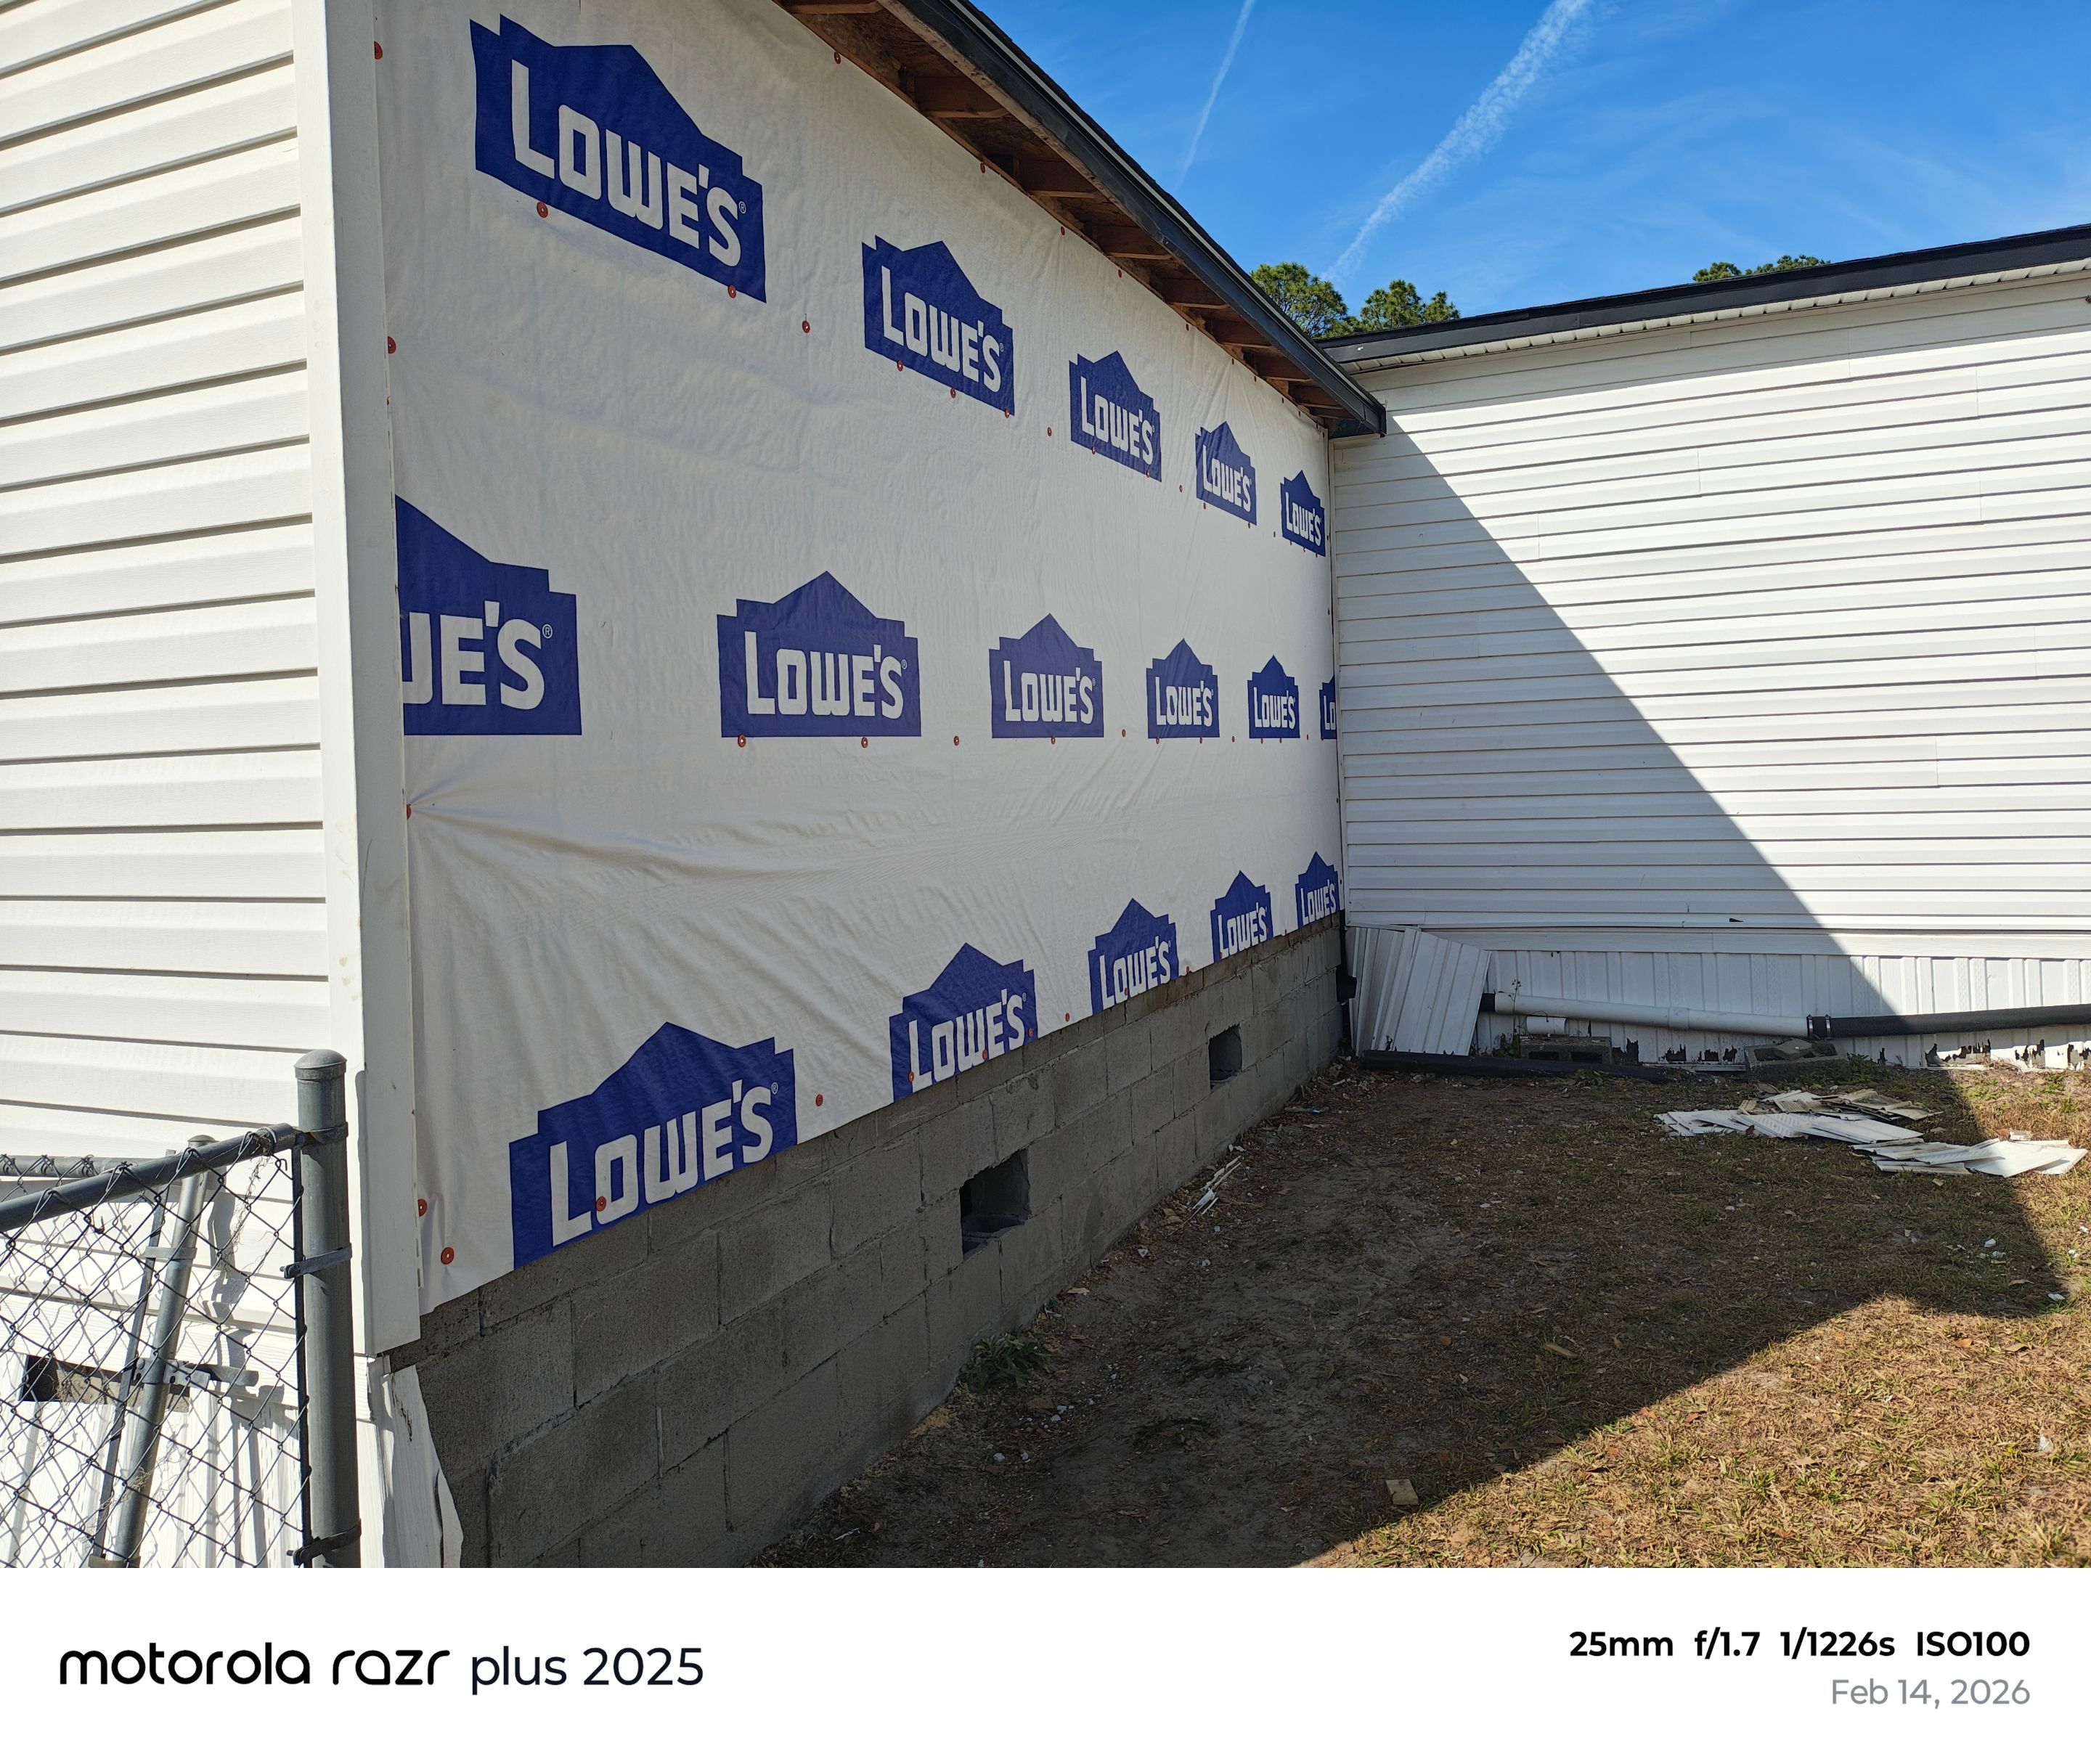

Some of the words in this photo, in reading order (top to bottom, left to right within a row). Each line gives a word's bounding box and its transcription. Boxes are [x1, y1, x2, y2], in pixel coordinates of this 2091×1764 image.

[511, 58, 742, 268] LOWE'S
[881, 266, 1002, 393] LOWE'S
[1080, 376, 1154, 465] LOWE'S
[1202, 444, 1252, 513] LOWE'S
[744, 629, 904, 720] LOWE'S
[1003, 660, 1094, 725] LOWE'S
[1154, 676, 1213, 727] LOWE'S
[1254, 686, 1295, 730] LOWE'S
